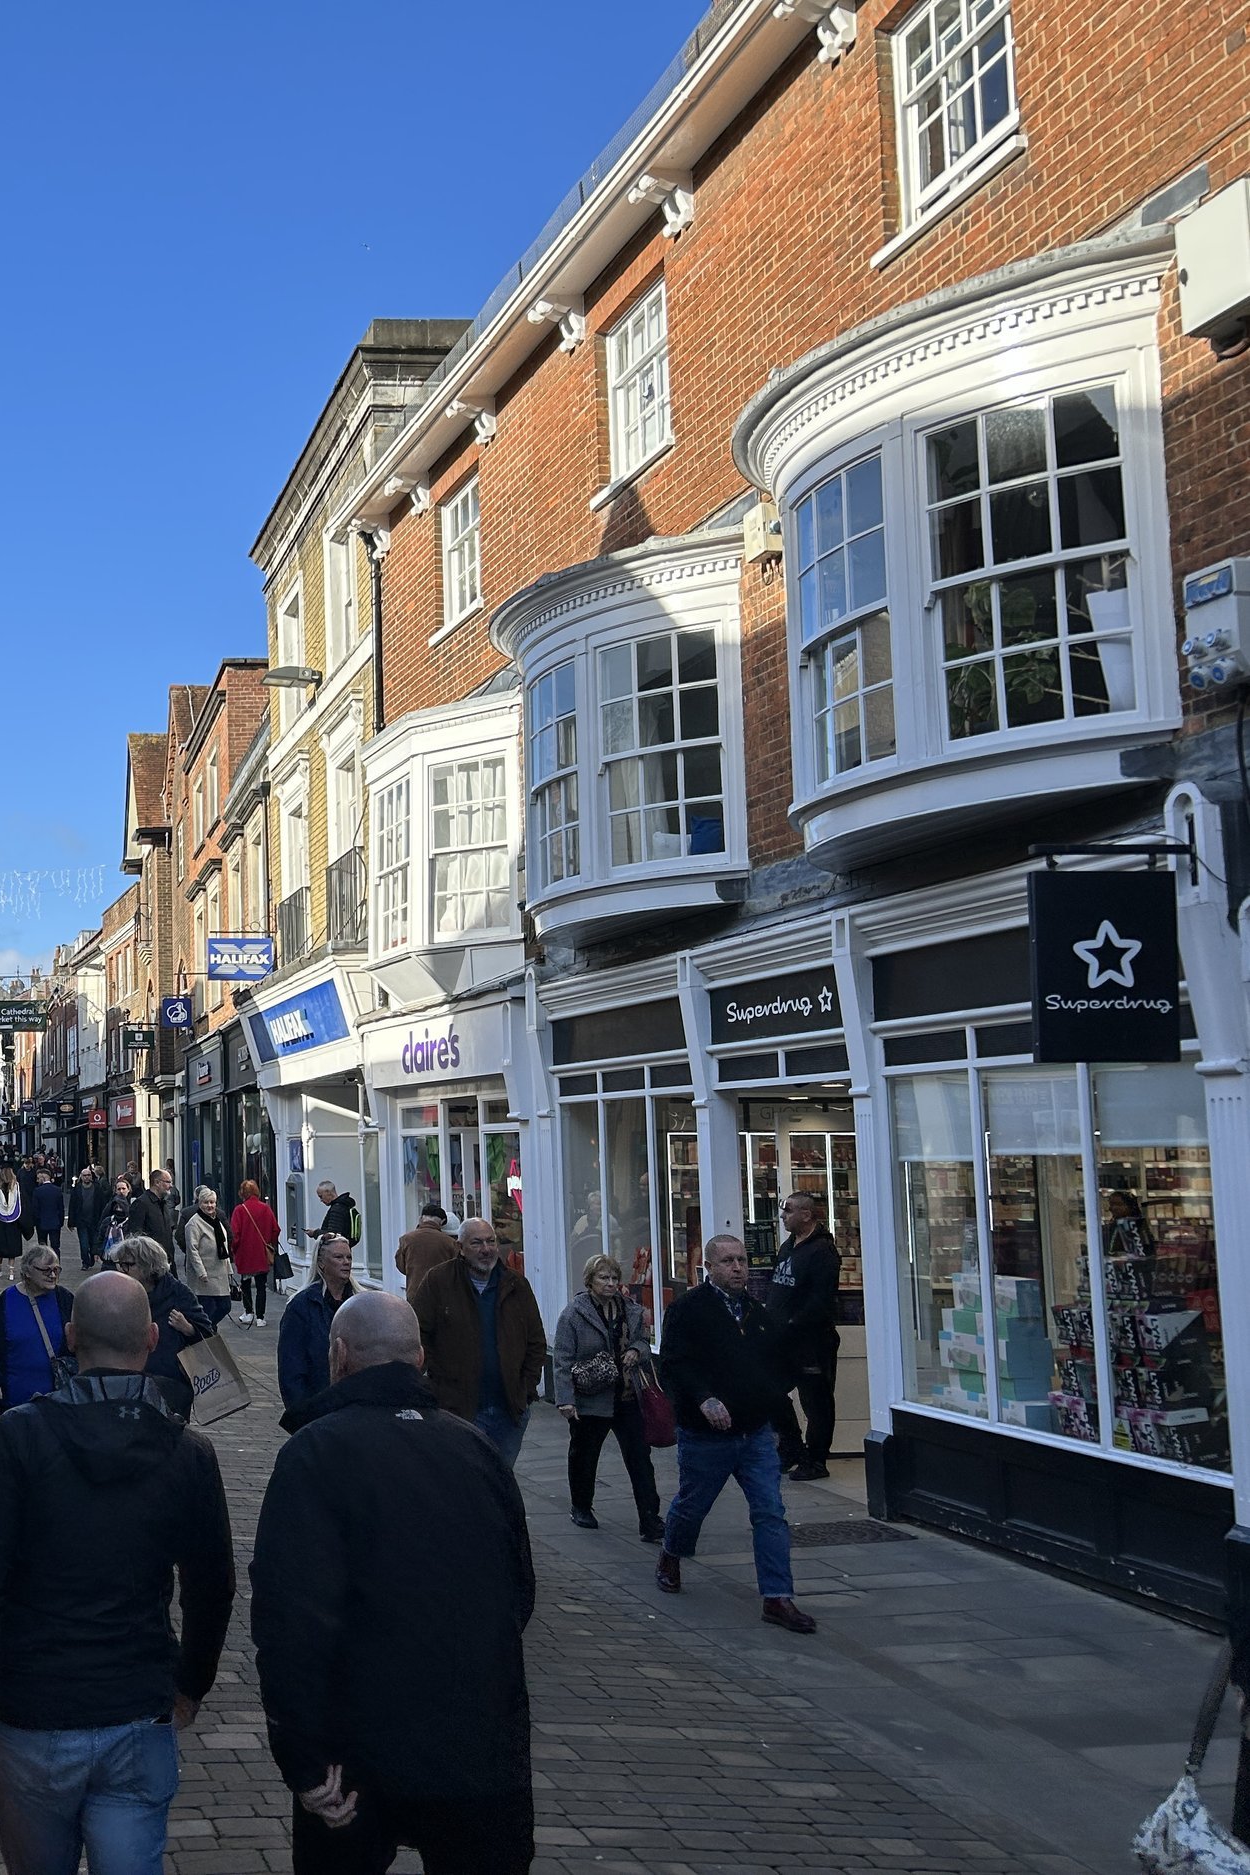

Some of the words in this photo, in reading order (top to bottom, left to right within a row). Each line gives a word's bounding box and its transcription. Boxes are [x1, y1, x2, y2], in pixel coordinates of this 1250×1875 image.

[210, 953, 270, 965] HALIFAX
[1, 1007, 35, 1015] Cathedral
[726, 995, 813, 1025] Superdrug
[1044, 994, 1173, 1014] Superdrug
[269, 1009, 309, 1045] HALIFAX
[402, 1023, 460, 1075] claire's
[1129, 1221, 1146, 1257] LYNX
[193, 1367, 221, 1397] Boots
